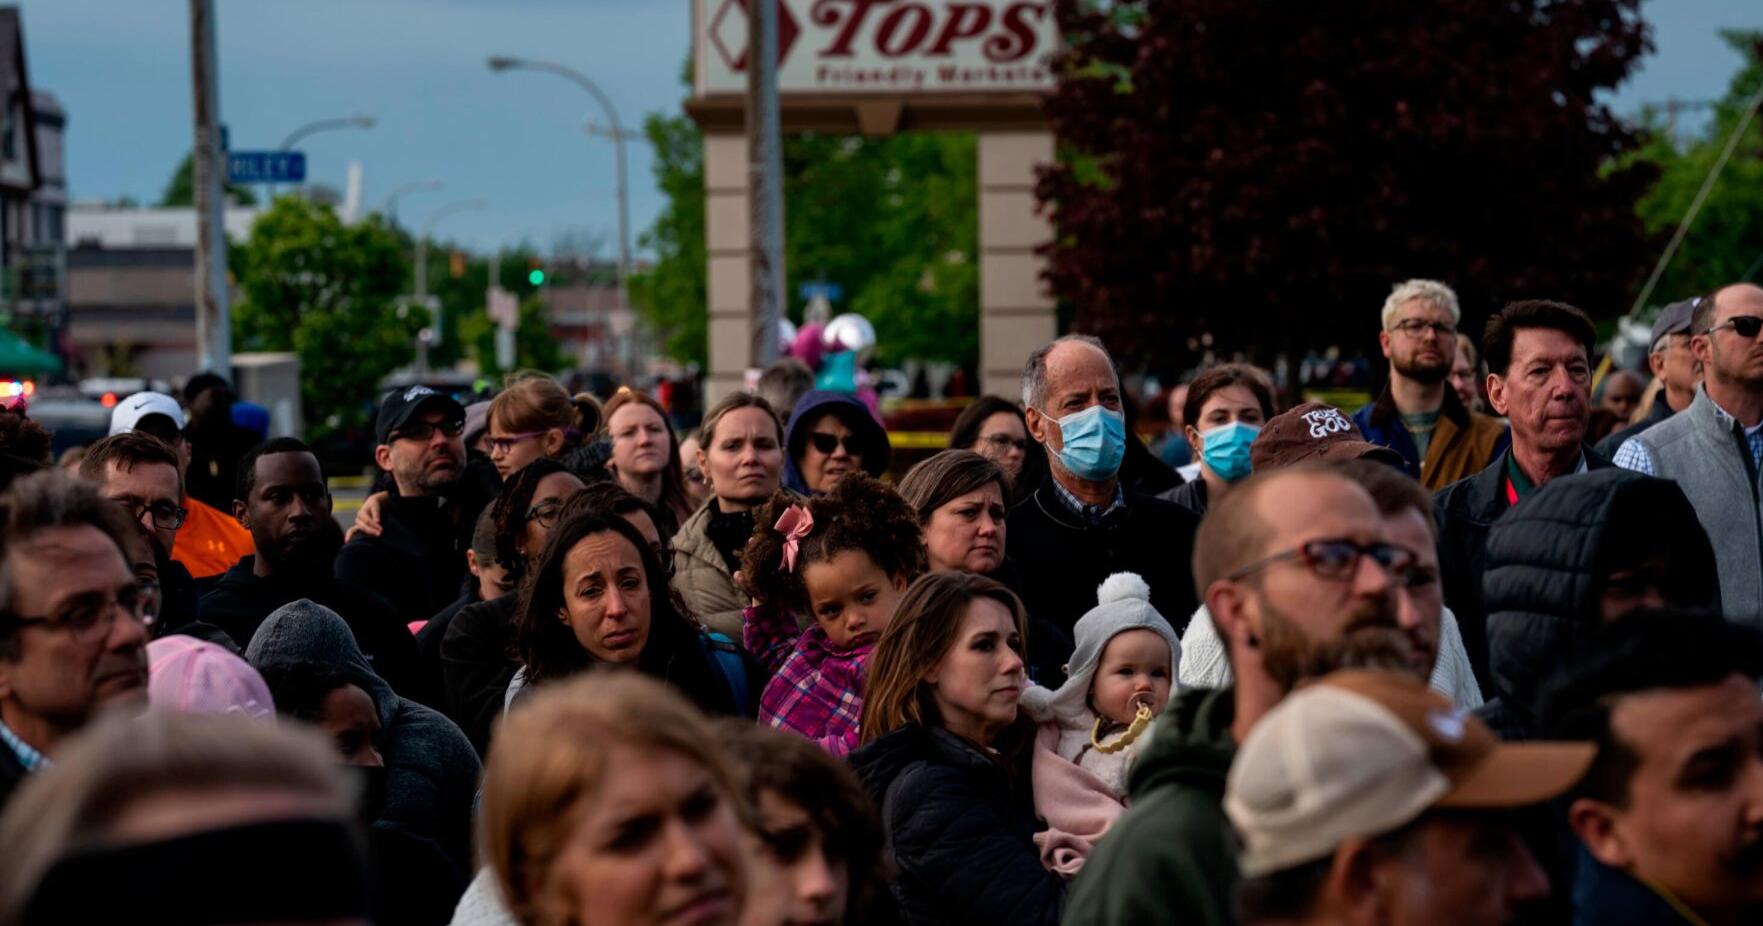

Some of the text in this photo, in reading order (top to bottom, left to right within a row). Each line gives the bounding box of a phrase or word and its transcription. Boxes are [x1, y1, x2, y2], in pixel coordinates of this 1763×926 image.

[810, 0, 1046, 63] TOPS
[816, 65, 925, 87] Friendly
[1310, 417, 1351, 438] GOD
